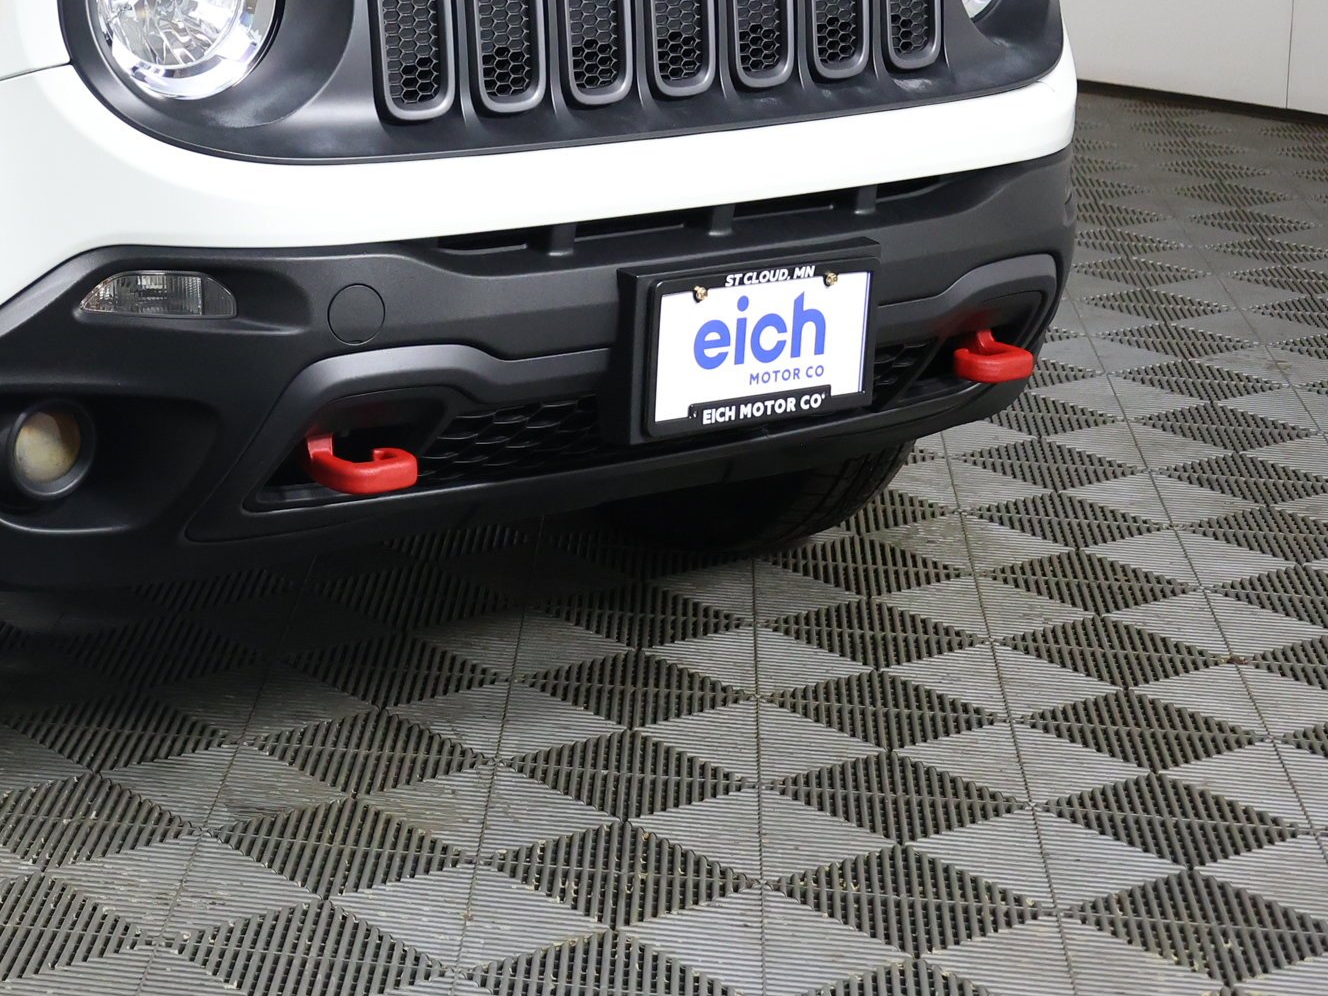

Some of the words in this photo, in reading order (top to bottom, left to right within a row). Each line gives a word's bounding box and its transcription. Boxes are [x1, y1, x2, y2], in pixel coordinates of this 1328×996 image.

[725, 273, 744, 287] ST
[743, 268, 791, 284] CLOUD,
[793, 265, 815, 279] MN
[693, 291, 826, 370] eich
[749, 368, 800, 385] MOTOR
[806, 365, 824, 378] CO
[702, 405, 736, 425] EICH
[739, 398, 796, 419] MOTOR
[800, 393, 822, 409] CO
